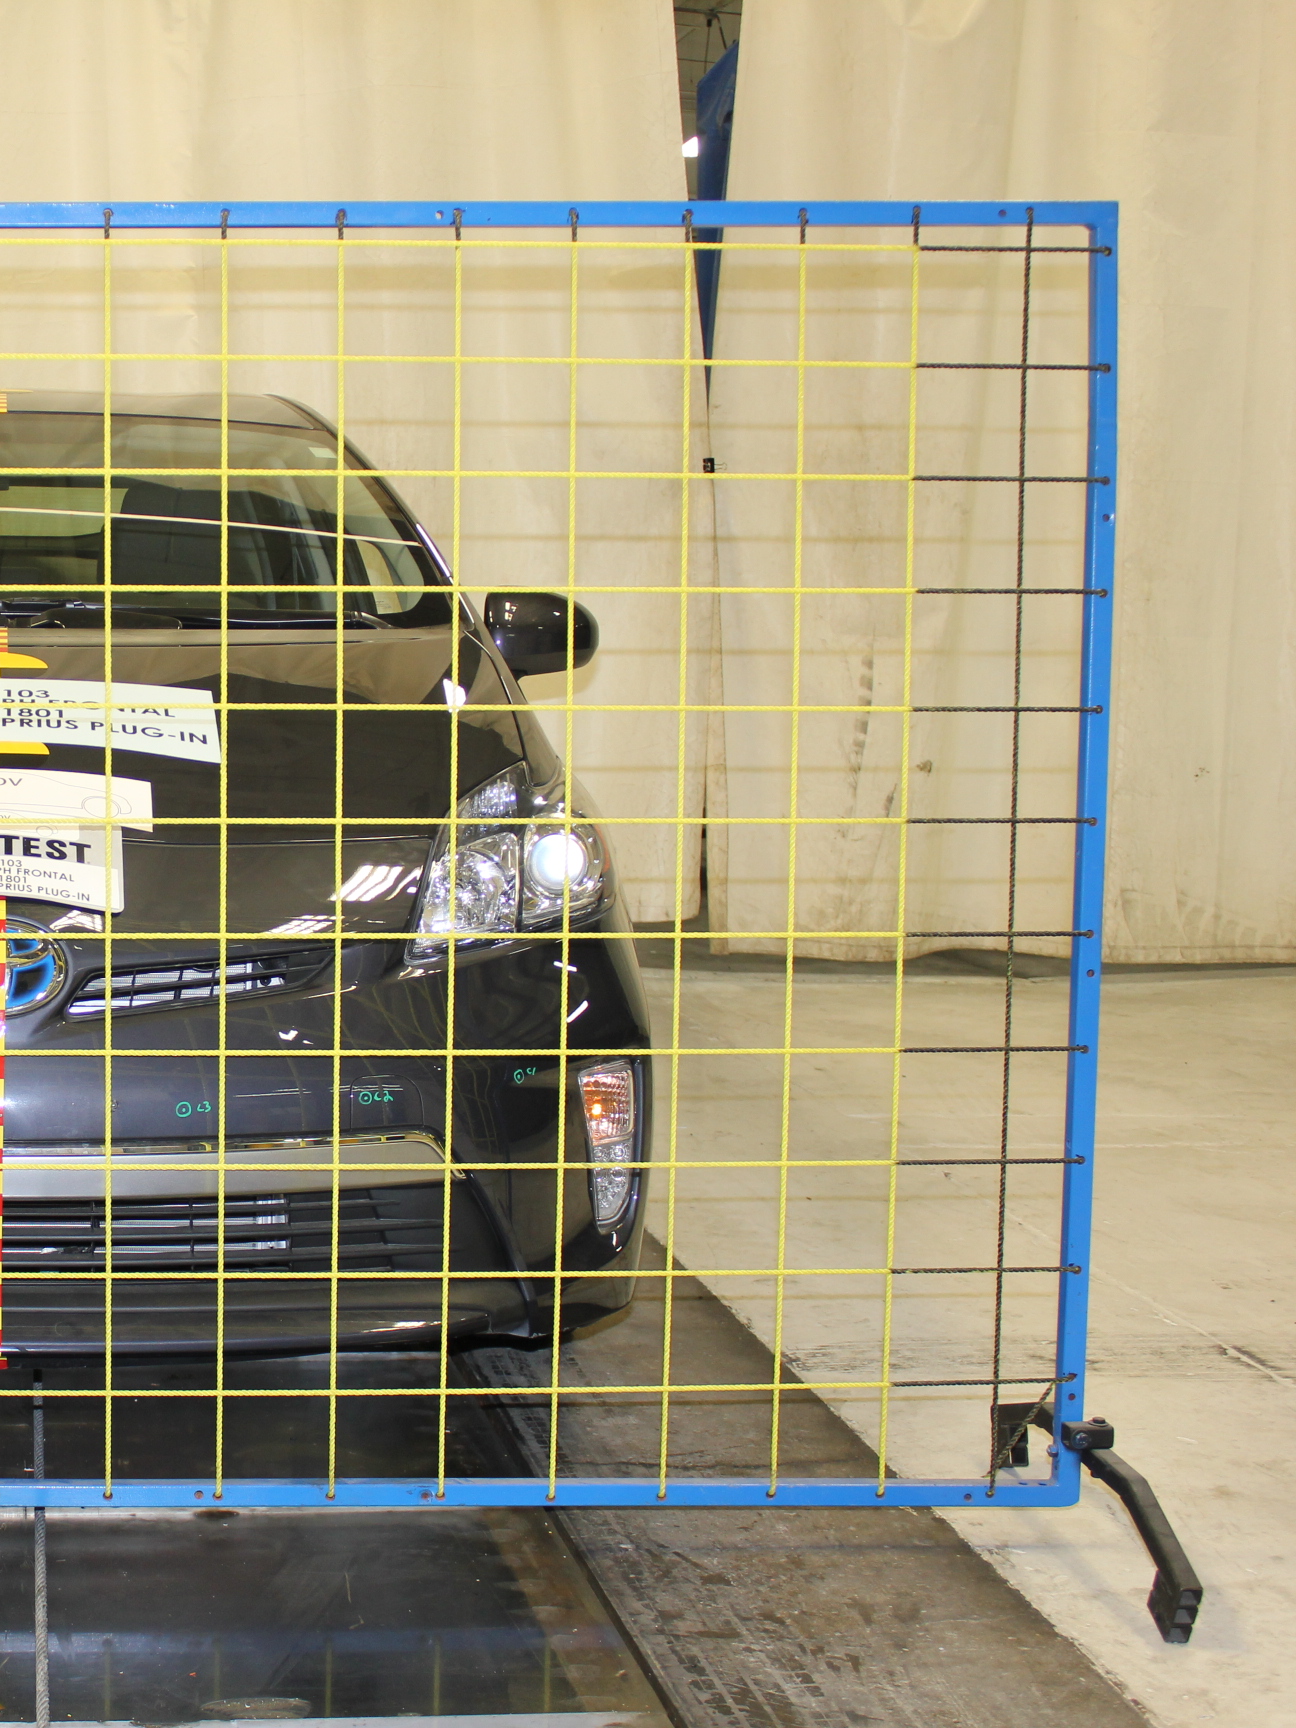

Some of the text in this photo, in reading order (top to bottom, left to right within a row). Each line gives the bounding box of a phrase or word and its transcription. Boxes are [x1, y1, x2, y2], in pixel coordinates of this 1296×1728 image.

[1, 718, 79, 730] PRIUS
[90, 721, 209, 745] PLUG-IN
[17, 867, 75, 883] FRONTAL
[37, 886, 91, 902] PLUG-IN
